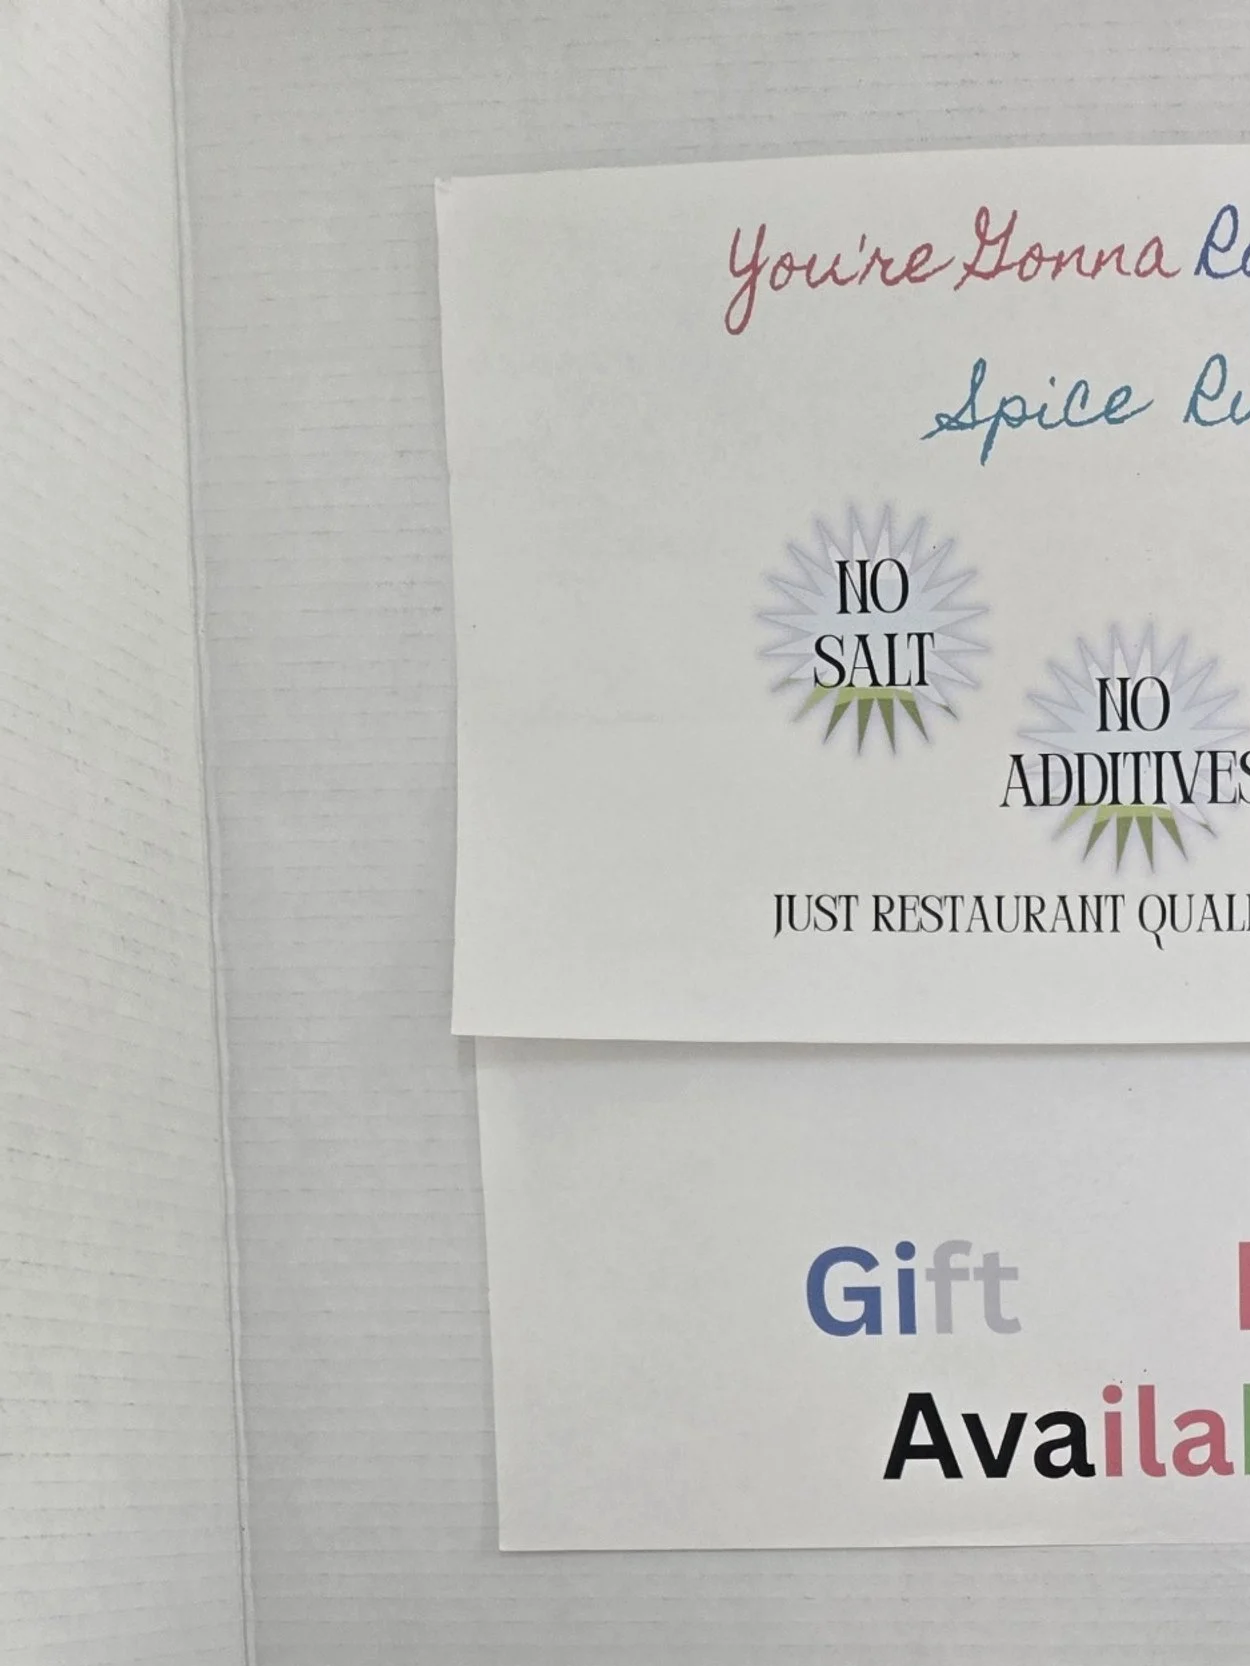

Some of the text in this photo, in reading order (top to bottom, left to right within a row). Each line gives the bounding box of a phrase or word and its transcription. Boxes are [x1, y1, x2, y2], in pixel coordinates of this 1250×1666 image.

[724, 224, 953, 335] You're
[953, 206, 1180, 292] Gonna
[920, 358, 1153, 466] Spice
[835, 558, 910, 614] NO
[812, 632, 936, 689] SALT
[1096, 676, 1171, 732] NO
[774, 894, 859, 938] JUST
[872, 893, 1126, 934] RESTAURANT
[806, 1240, 1022, 1338] Gift
